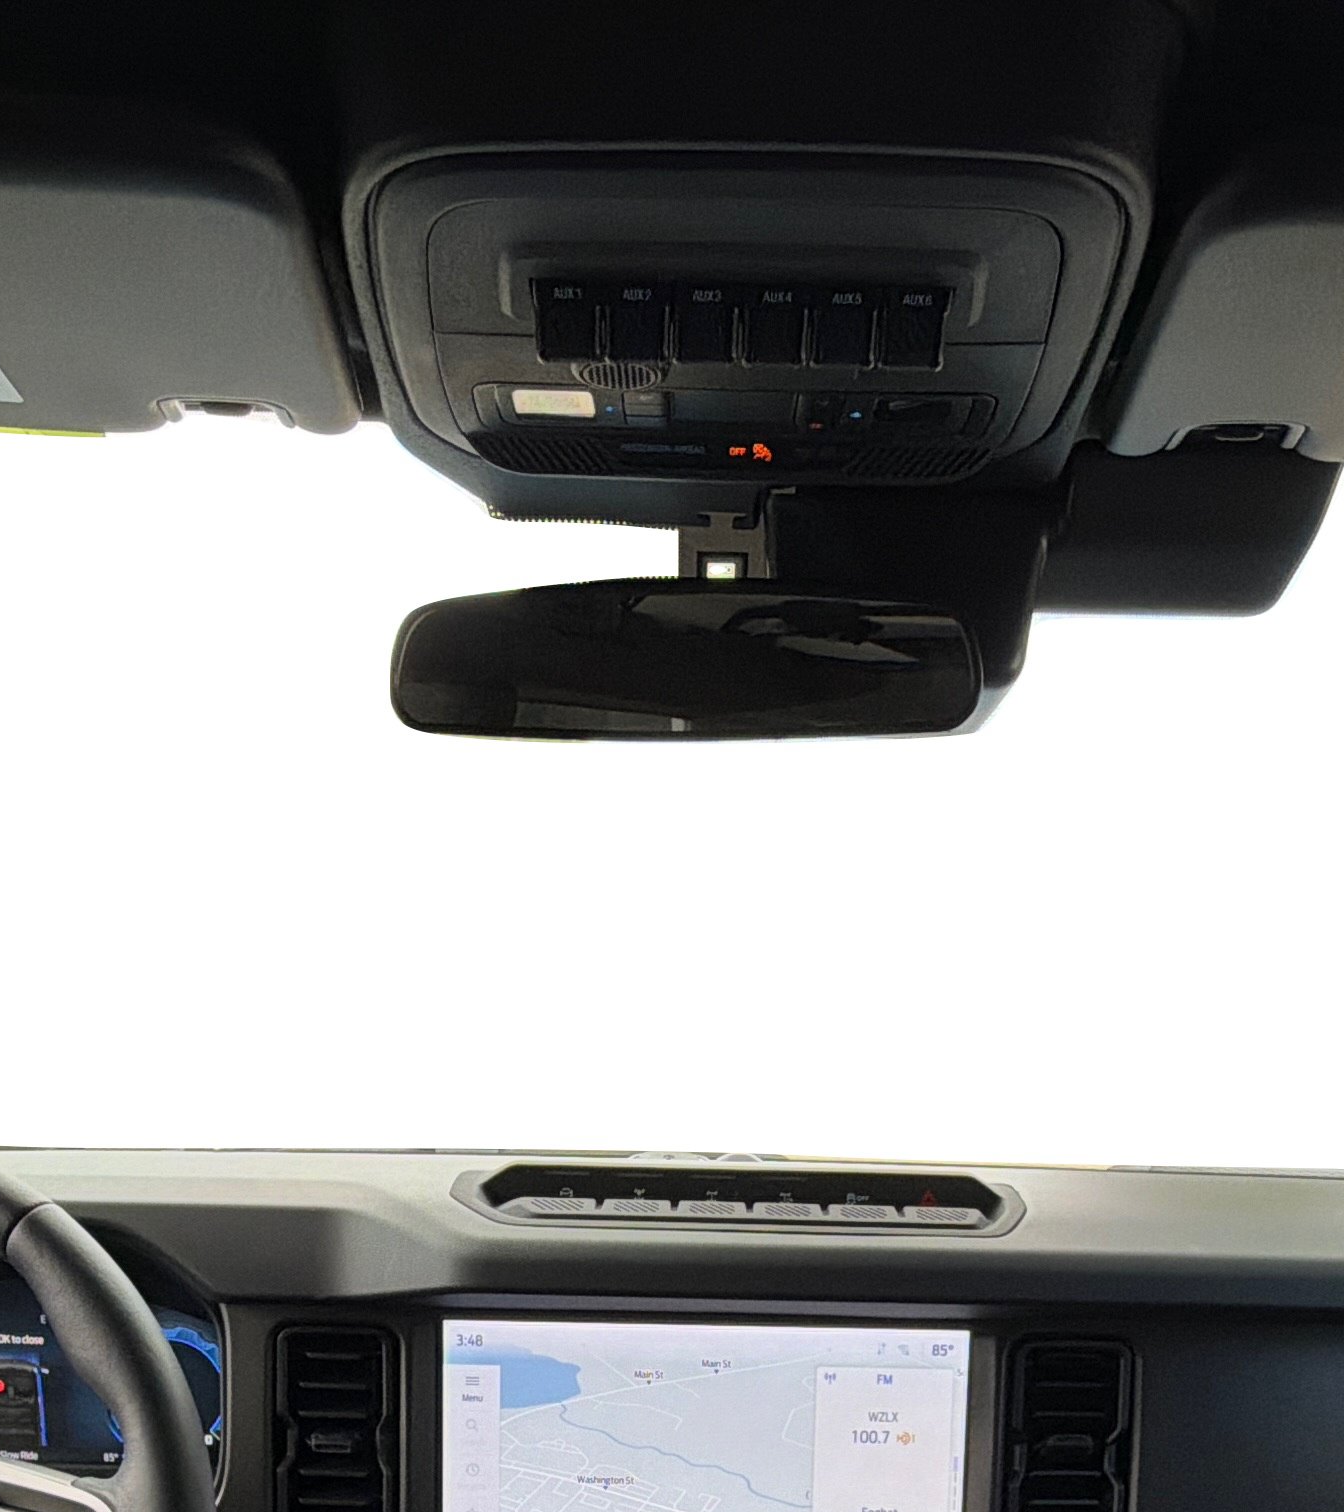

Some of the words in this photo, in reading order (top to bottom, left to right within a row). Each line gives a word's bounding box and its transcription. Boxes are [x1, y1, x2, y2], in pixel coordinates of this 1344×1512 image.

[729, 447, 746, 456] OFF
[11, 1334, 21, 1344] to
[22, 1335, 44, 1345] close
[456, 1334, 483, 1347] 3:48
[932, 1344, 954, 1357] 85°
[701, 1360, 721, 1368] Main
[722, 1359, 732, 1368] St
[634, 1370, 654, 1379] Main
[655, 1370, 664, 1379] St
[876, 1374, 893, 1385] FM
[461, 1394, 484, 1402] Menu
[868, 1412, 899, 1423] WZLX
[852, 1430, 890, 1444] 100.7
[577, 1475, 624, 1486] Washington
[625, 1475, 635, 1485] St
